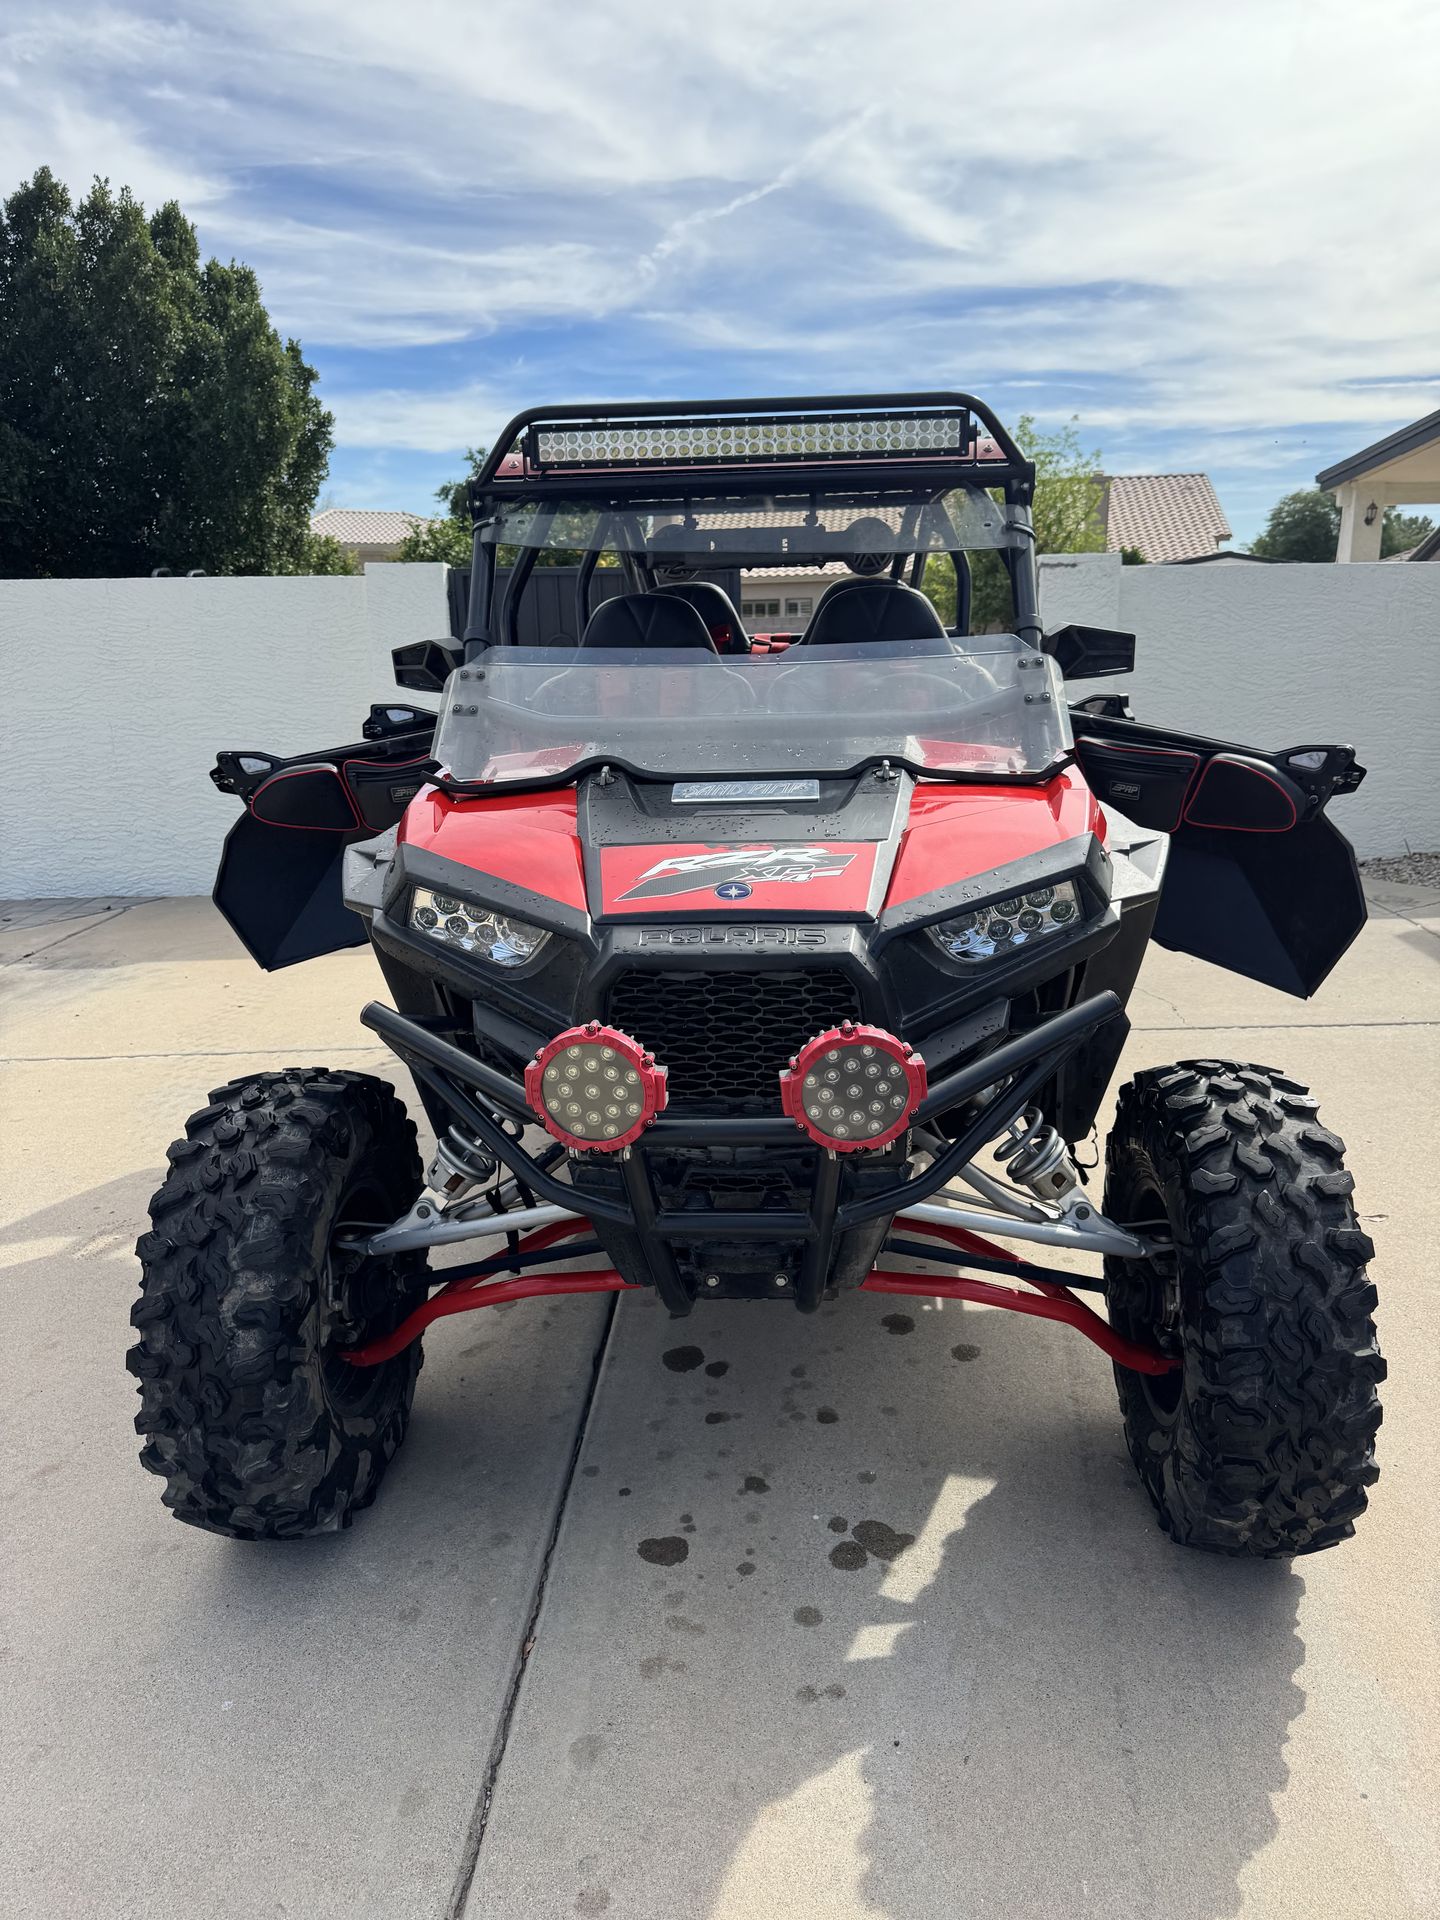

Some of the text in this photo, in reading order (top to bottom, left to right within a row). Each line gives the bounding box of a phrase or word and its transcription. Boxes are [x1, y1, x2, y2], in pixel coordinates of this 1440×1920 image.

[1113, 784, 1138, 793] PRP
[634, 848, 831, 880] RZR
[638, 926, 827, 946] POLARIS
